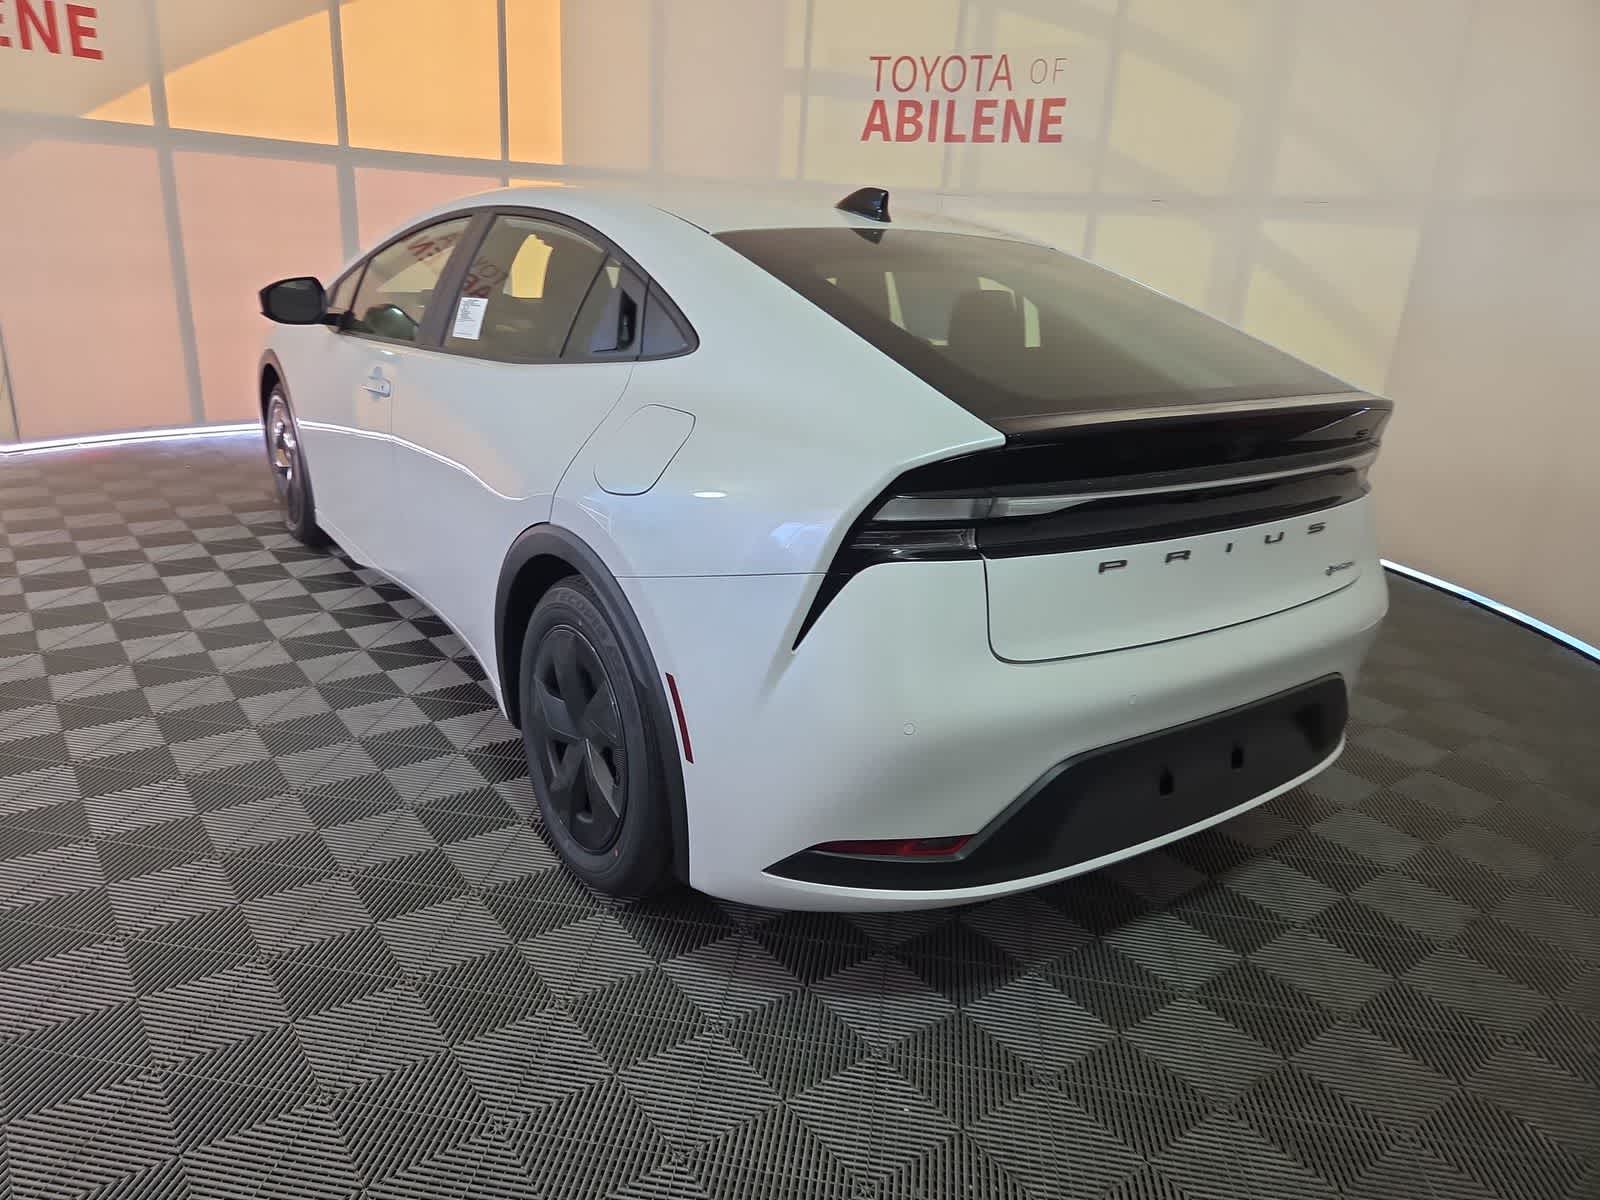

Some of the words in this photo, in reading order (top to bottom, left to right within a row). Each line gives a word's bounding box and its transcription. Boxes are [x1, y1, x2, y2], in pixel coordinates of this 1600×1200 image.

[869, 54, 1013, 93] TOYOTA
[1030, 57, 1067, 84] OF
[860, 97, 1067, 143] ABILENE
[1098, 521, 1327, 574] PRIUS
